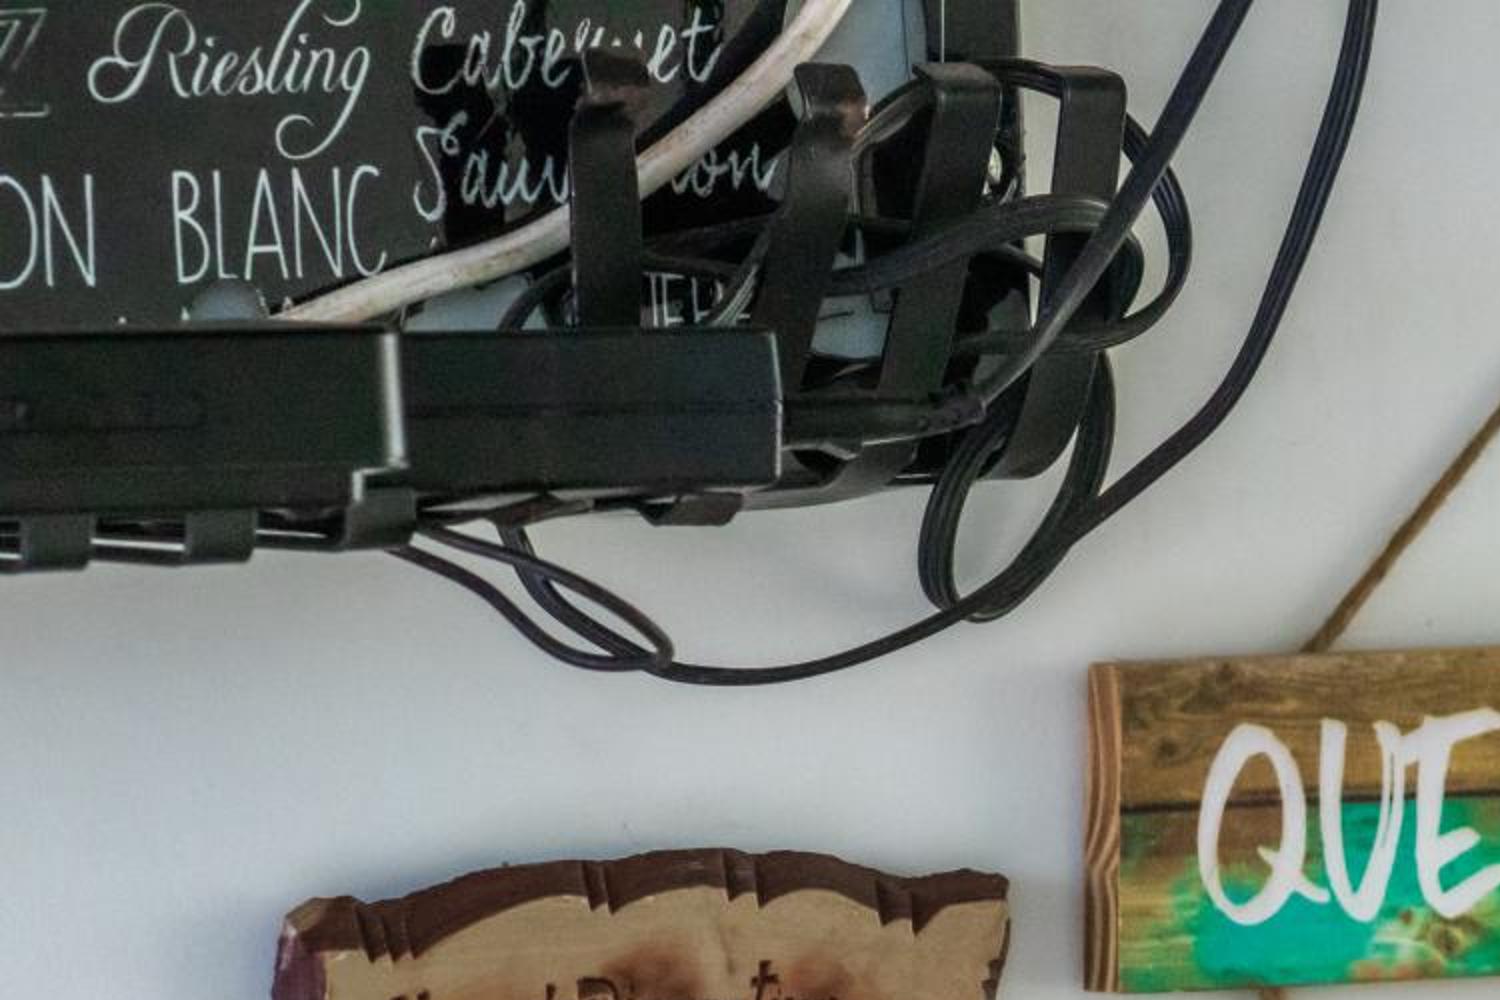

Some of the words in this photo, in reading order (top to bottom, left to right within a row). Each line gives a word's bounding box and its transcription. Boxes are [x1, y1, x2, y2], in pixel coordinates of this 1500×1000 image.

[87, 0, 371, 160] Riesling
[412, 0, 722, 94] Cabeet
[413, 111, 780, 222] Sauvon
[171, 165, 388, 286] BLANC
